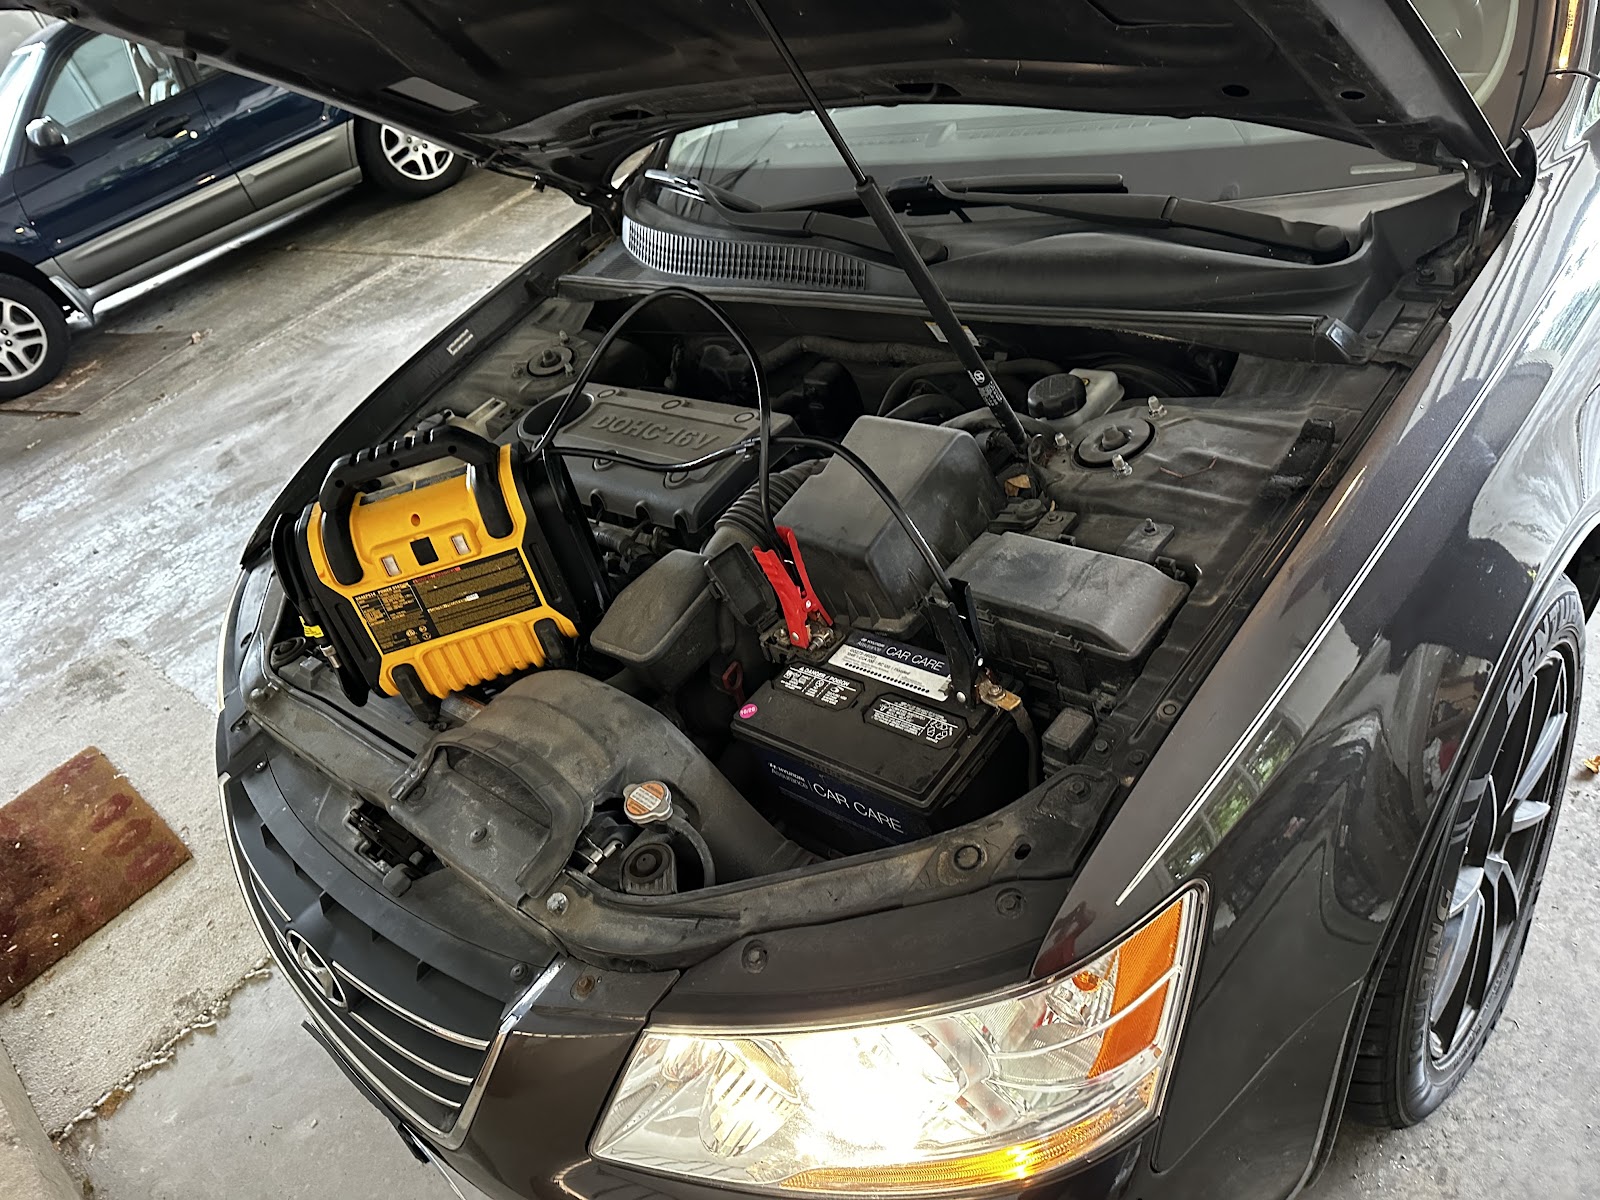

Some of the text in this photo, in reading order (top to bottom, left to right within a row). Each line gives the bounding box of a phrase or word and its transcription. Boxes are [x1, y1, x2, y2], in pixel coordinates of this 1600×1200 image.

[592, 415, 667, 442] DOHC
[886, 646, 912, 661] CAR
[911, 654, 945, 672] CARE
[804, 668, 826, 679] DANGER
[829, 675, 850, 687] POISON
[813, 783, 904, 834] CAR CARE
